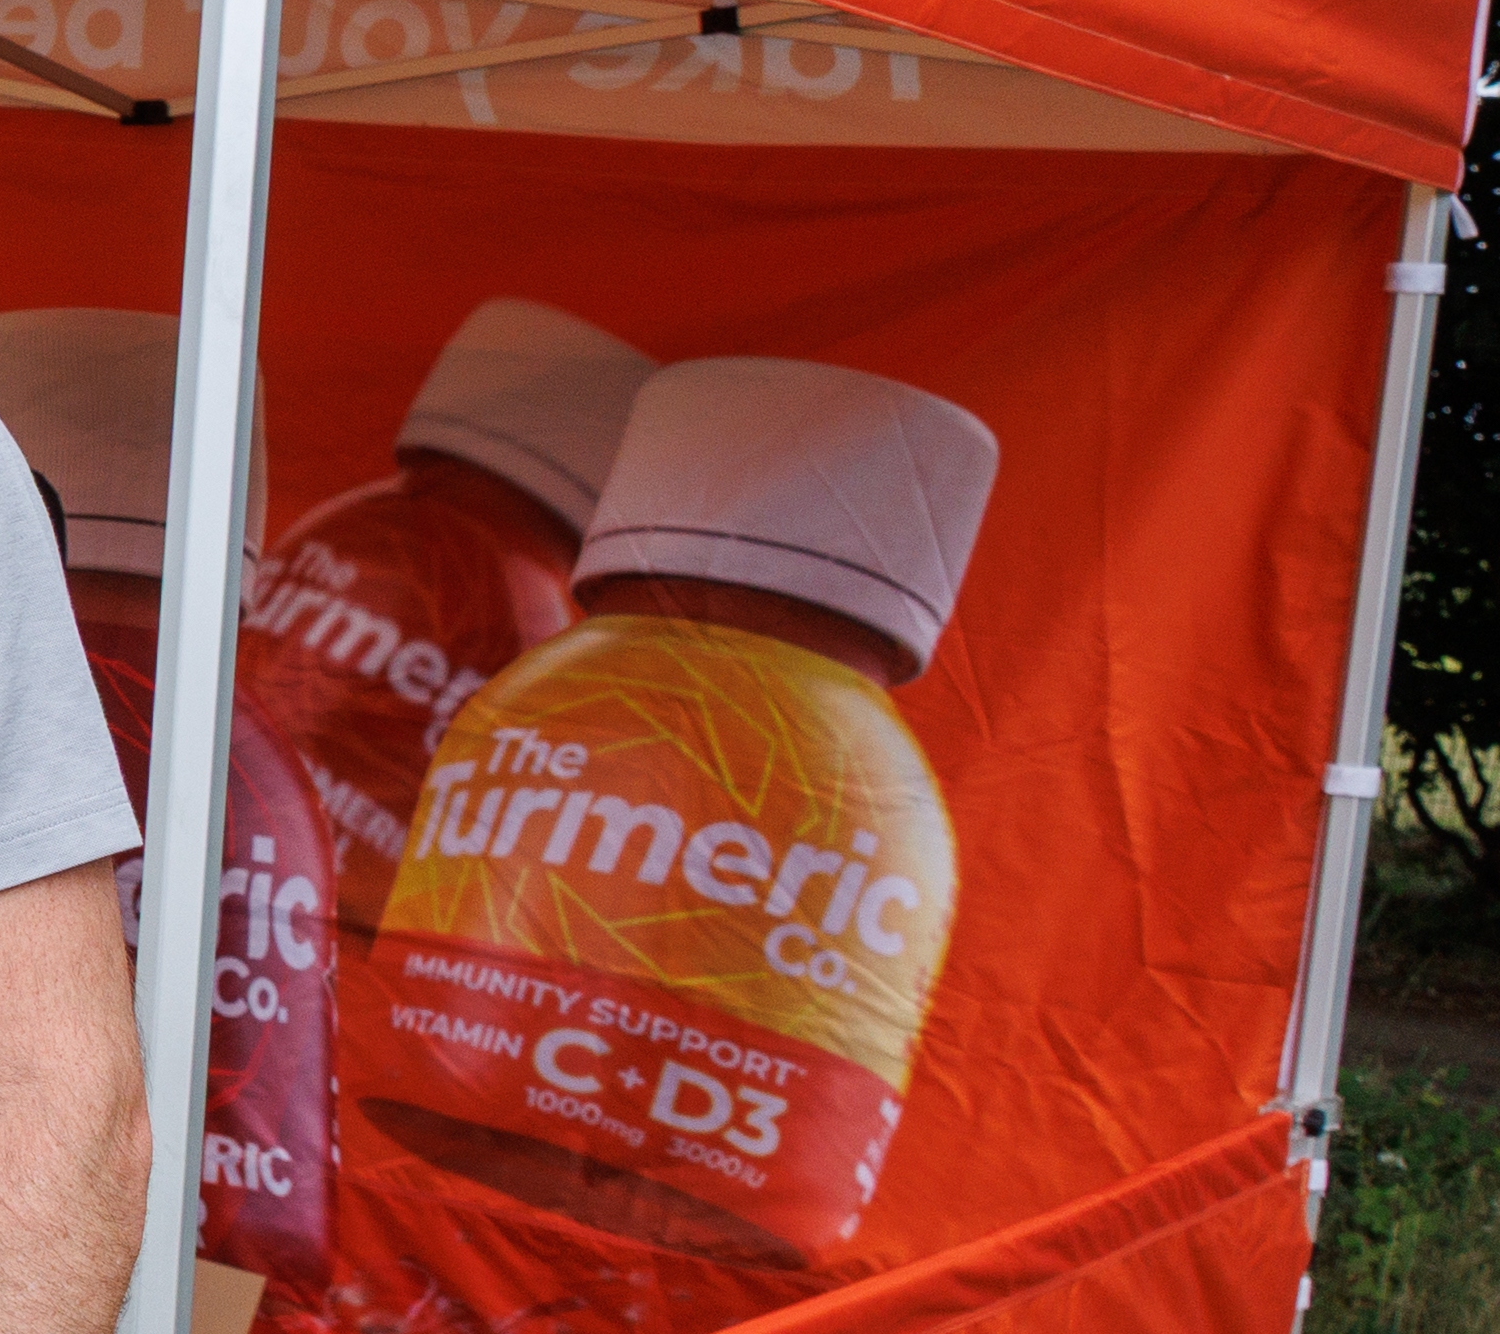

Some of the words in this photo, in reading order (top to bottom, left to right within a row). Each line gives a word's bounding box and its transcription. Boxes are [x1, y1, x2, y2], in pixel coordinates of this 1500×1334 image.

[486, 727, 589, 779] The
[415, 759, 921, 957] Turmeric
[212, 956, 289, 1024] Co.
[402, 953, 583, 1015] IMMUNITY
[763, 921, 857, 996] Co.
[390, 1003, 525, 1060] VITAMIN
